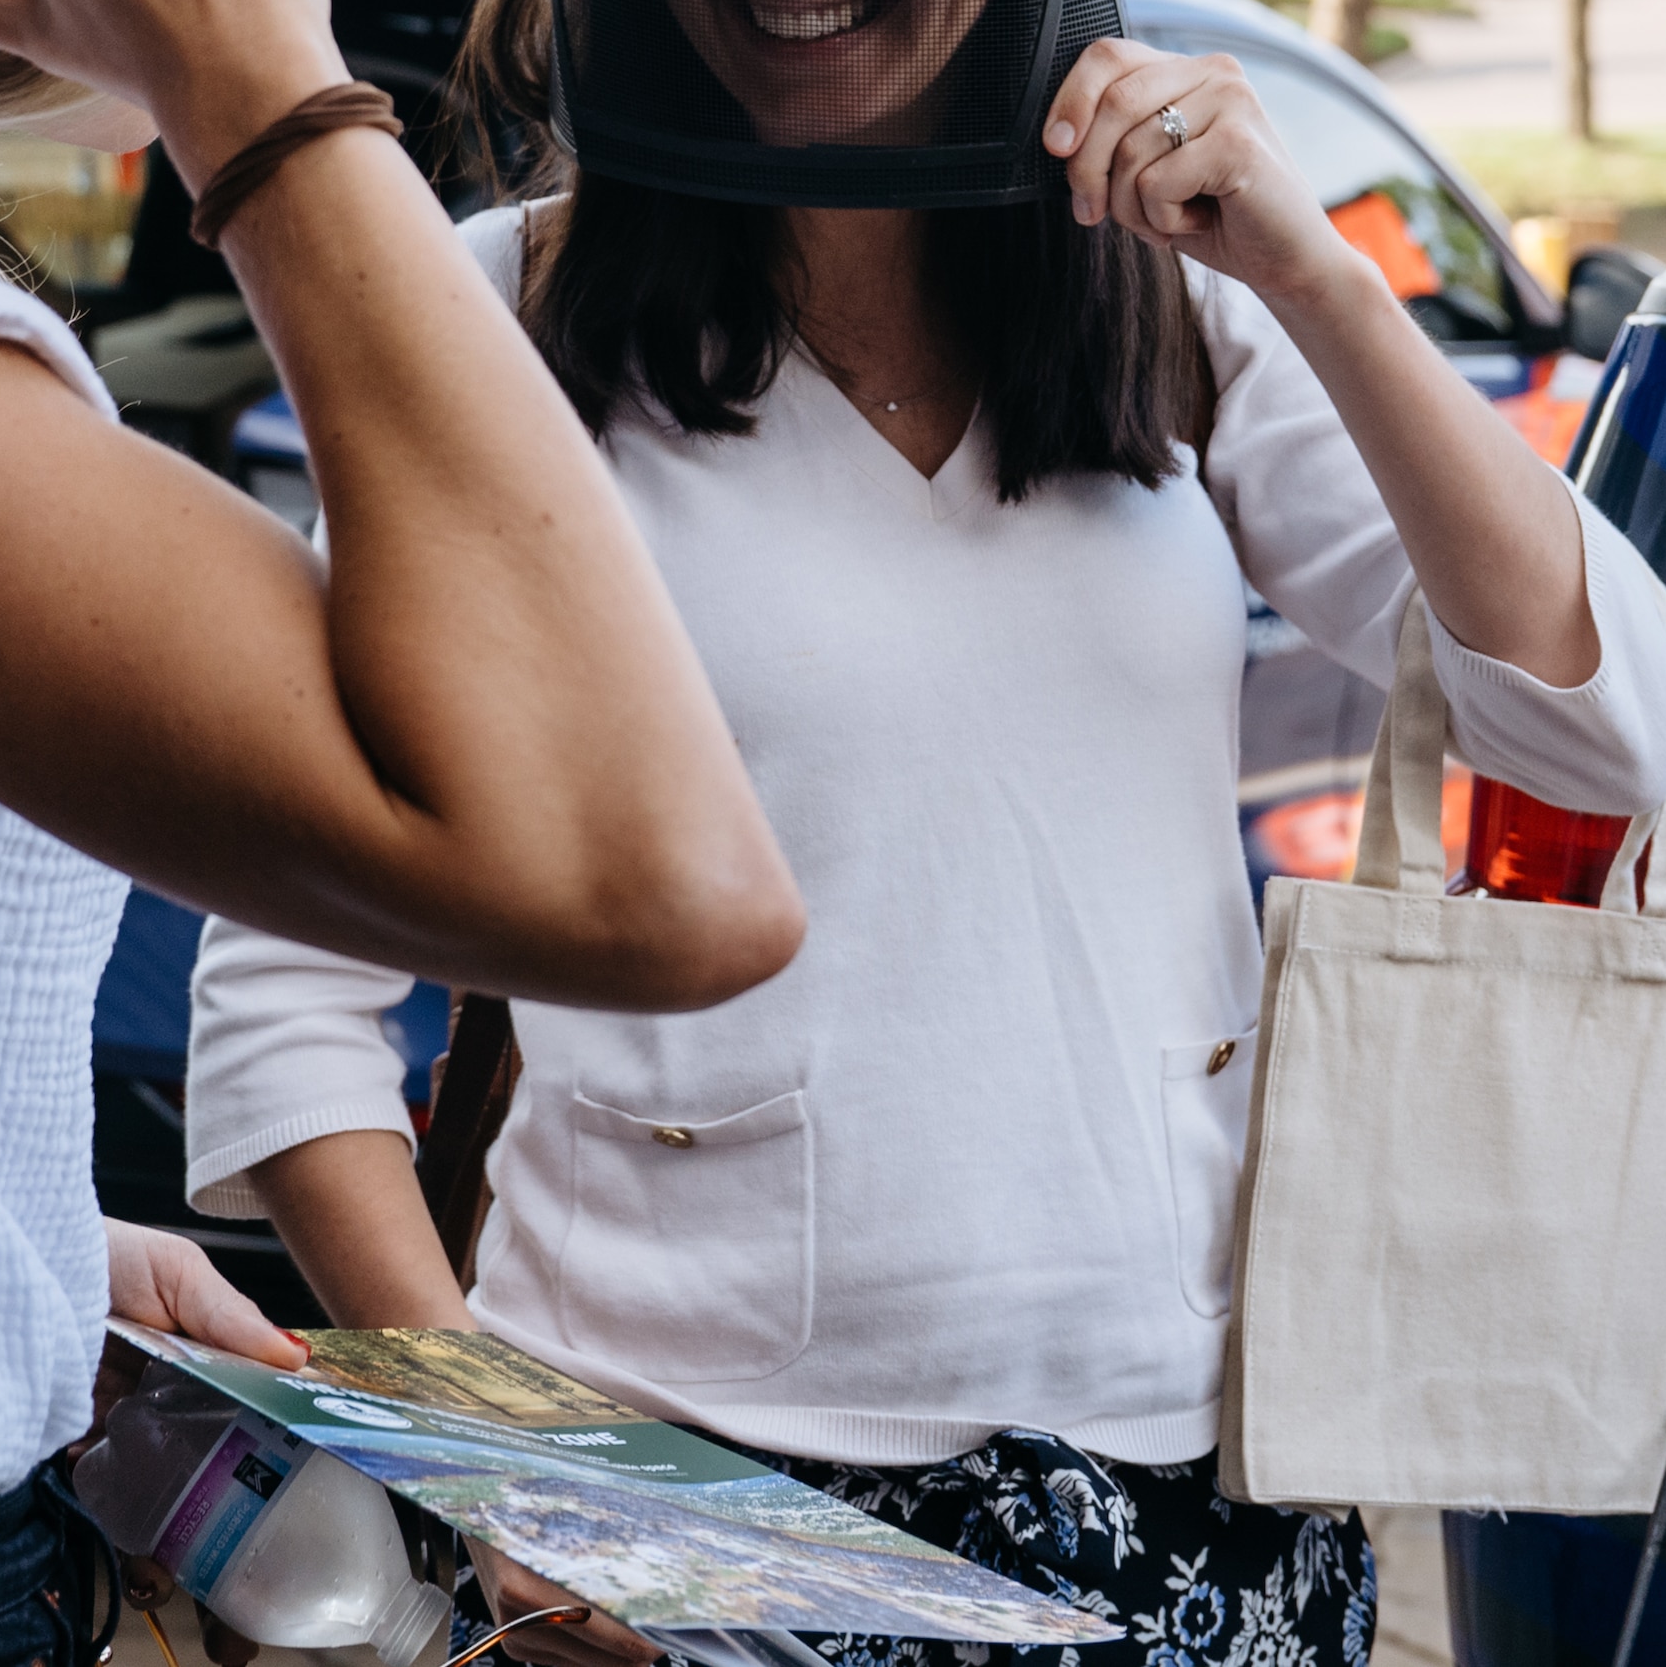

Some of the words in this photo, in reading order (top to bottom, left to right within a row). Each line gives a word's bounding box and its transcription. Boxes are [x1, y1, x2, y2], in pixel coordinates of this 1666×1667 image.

[542, 1431, 627, 1447] ZONE
[177, 1499, 211, 1545] RECYCLE
[214, 1501, 250, 1551] PURIFIED
